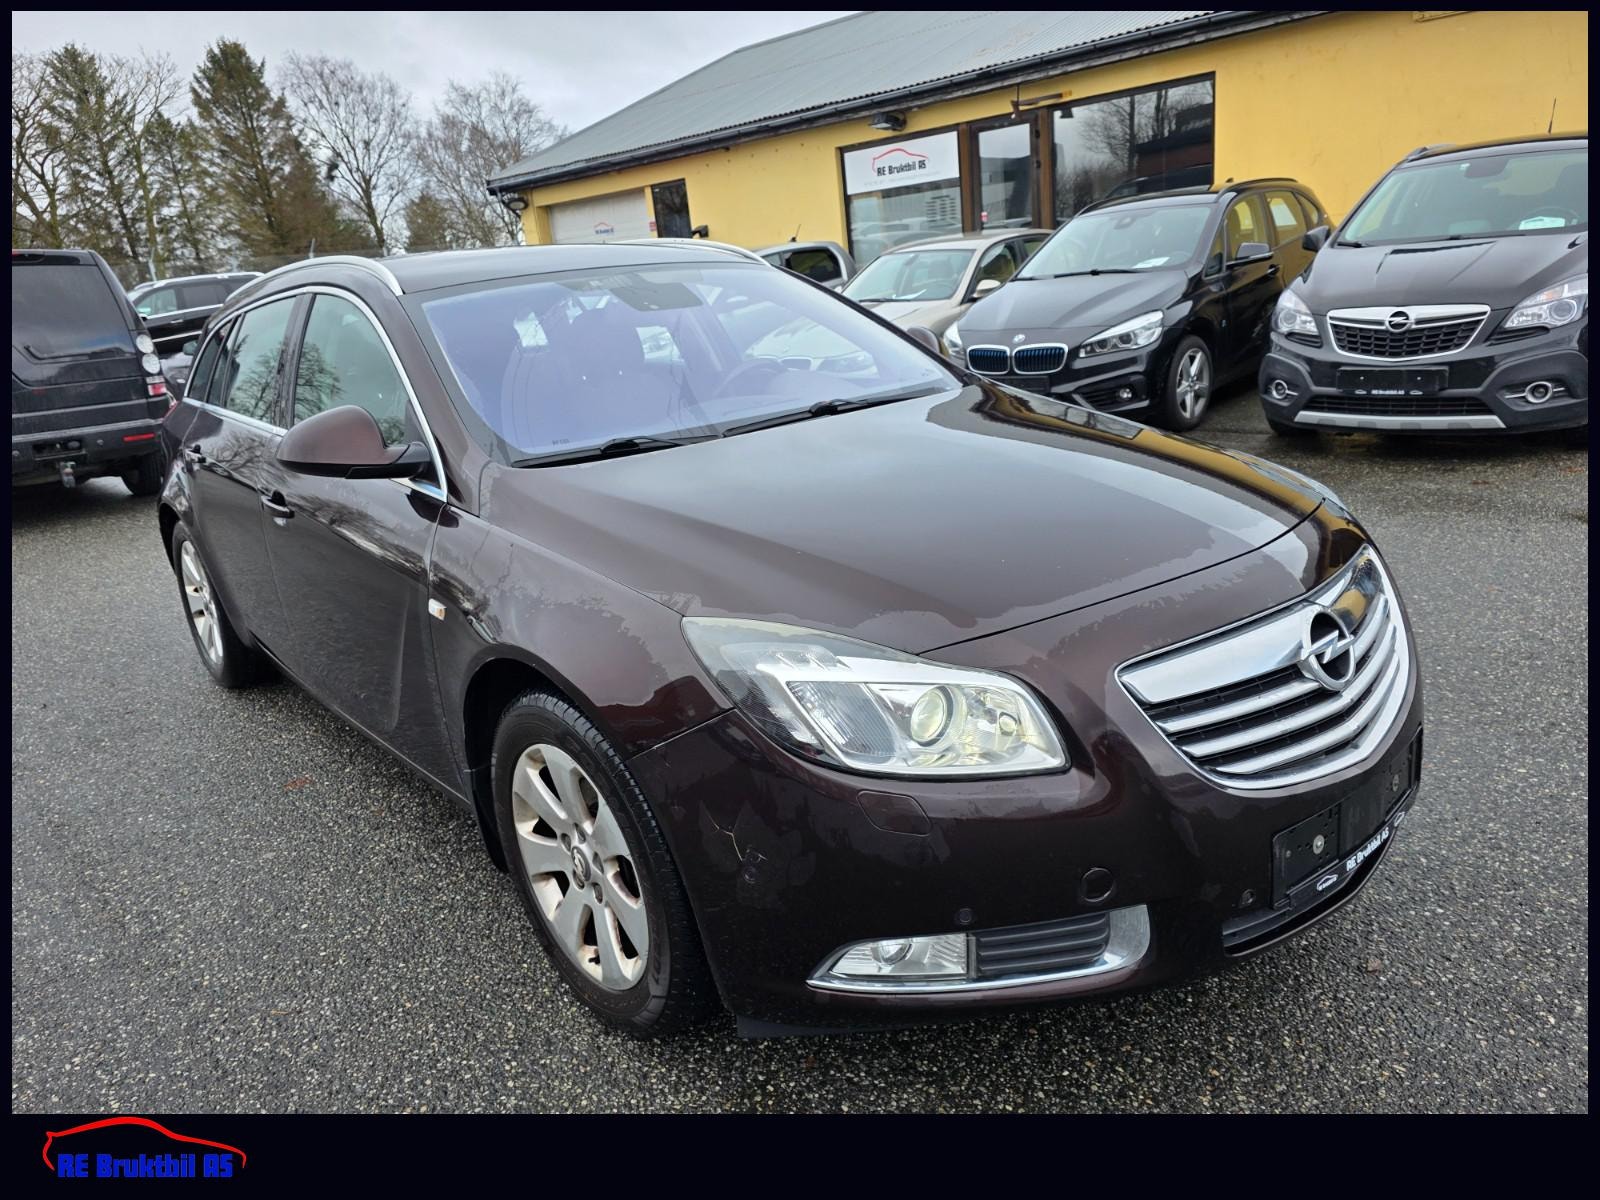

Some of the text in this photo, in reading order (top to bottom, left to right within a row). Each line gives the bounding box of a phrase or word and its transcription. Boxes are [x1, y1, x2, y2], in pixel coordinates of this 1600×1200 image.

[877, 167, 886, 176] RE
[888, 161, 916, 174] Bruktbil
[918, 160, 926, 169] AS
[1346, 856, 1356, 871] RE
